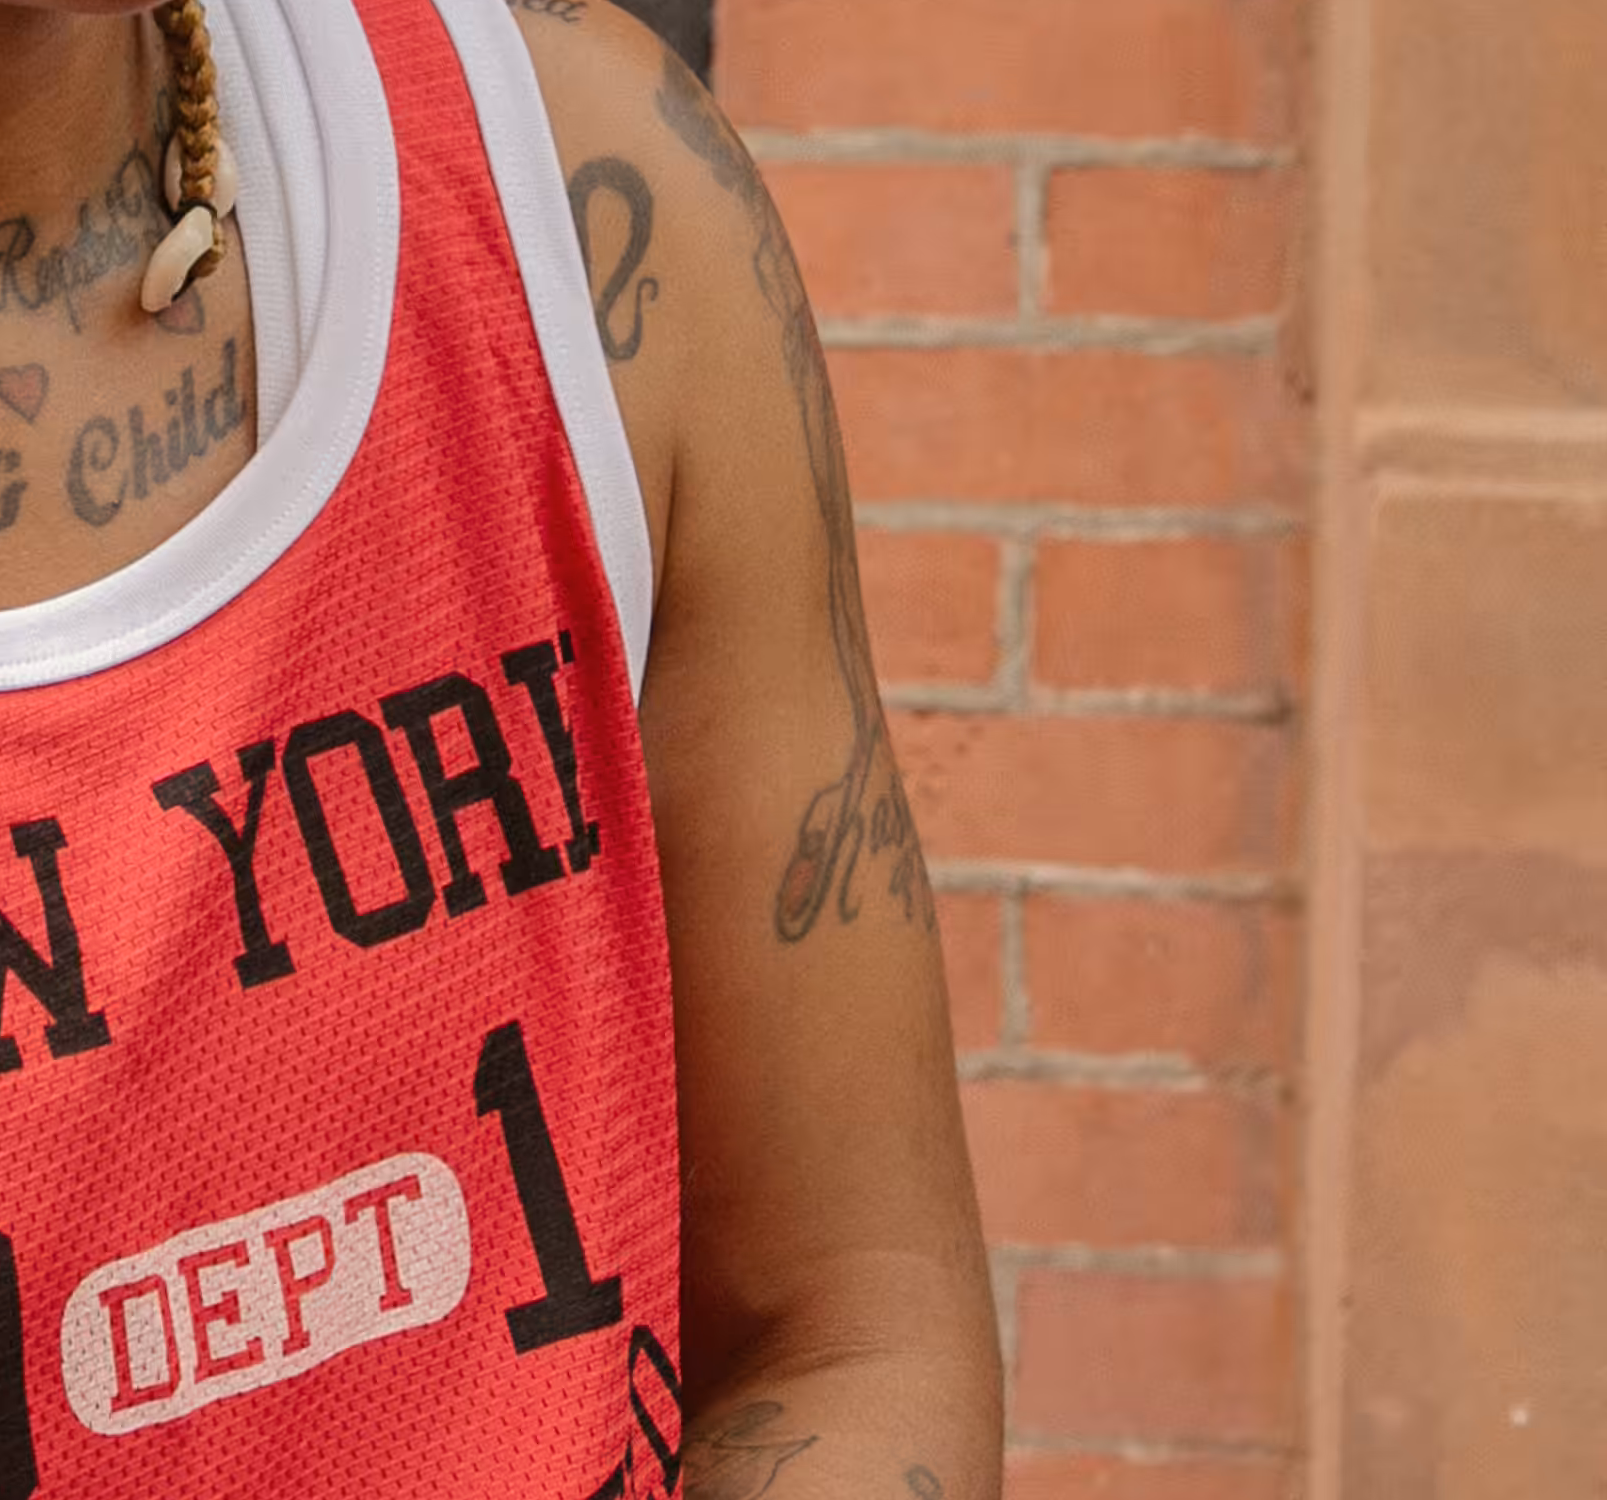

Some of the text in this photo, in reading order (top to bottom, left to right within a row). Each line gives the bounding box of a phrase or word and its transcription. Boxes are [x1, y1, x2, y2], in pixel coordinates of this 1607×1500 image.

[65, 338, 249, 528] Child
[98, 1174, 427, 1414] DEPT
[471, 1018, 625, 1356] 1
